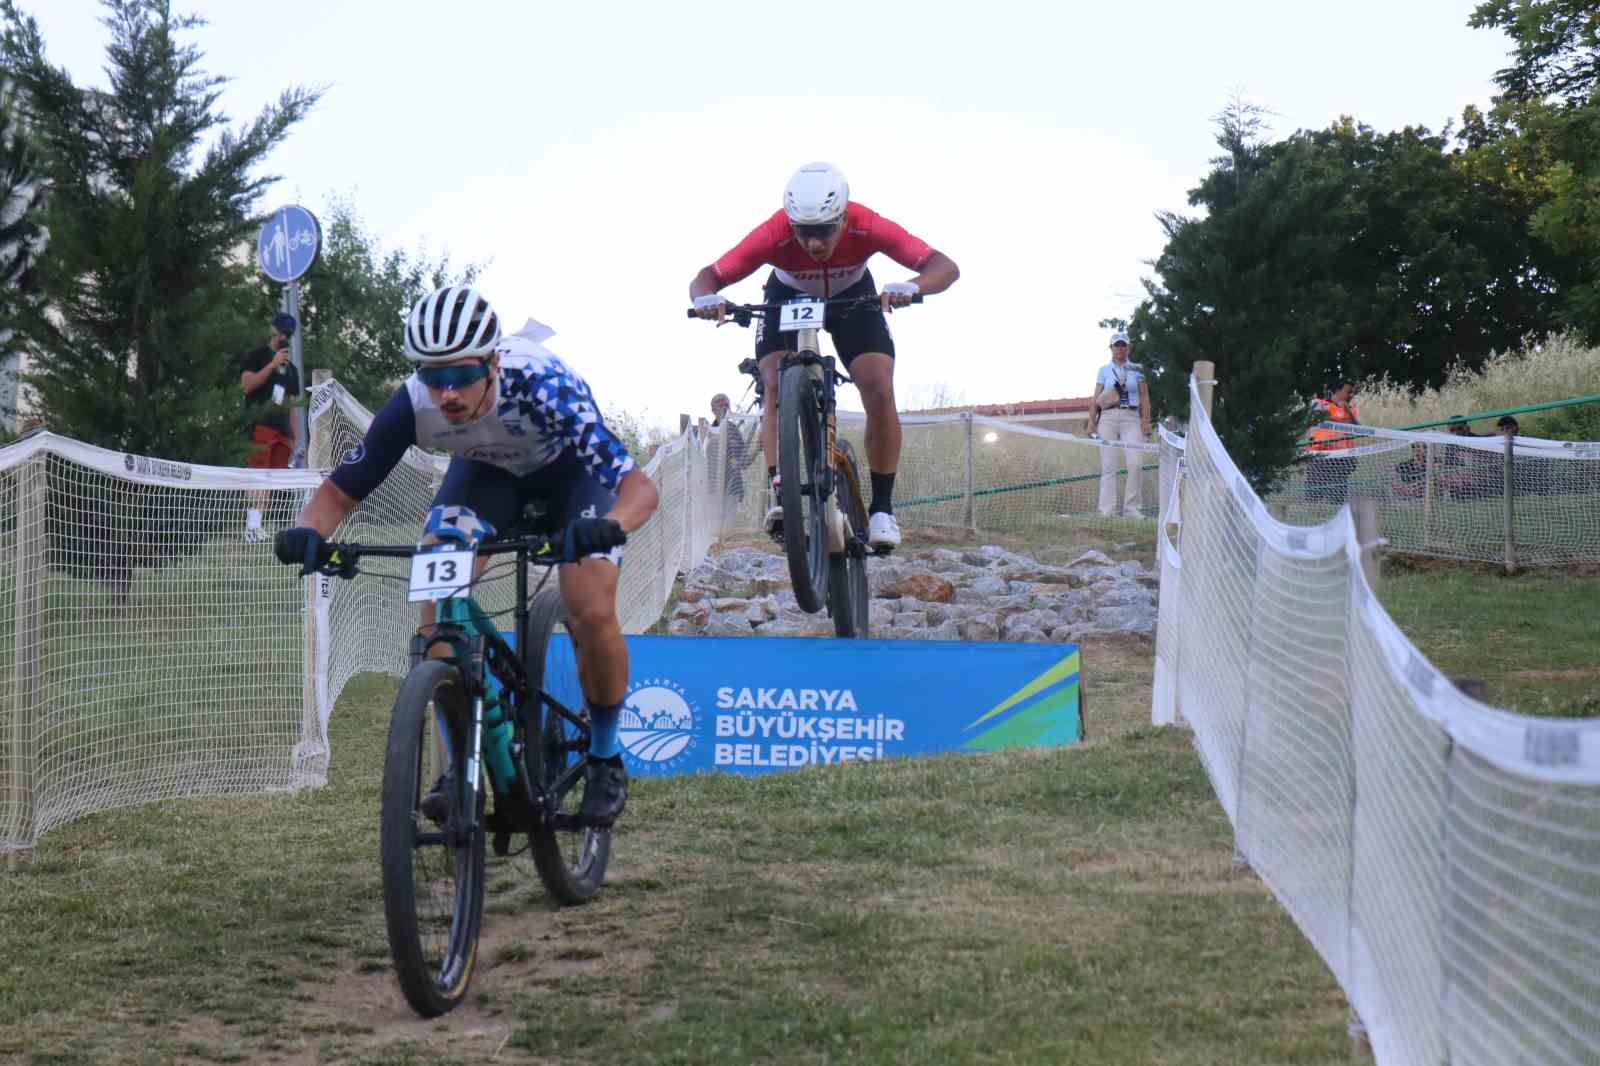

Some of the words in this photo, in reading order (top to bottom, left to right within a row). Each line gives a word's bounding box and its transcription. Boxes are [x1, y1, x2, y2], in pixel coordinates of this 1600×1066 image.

[791, 306, 814, 320] 12
[426, 560, 457, 583] 13
[716, 686, 858, 711] SAKARYA
[715, 710, 905, 742] BÜYÜKŞEHİR
